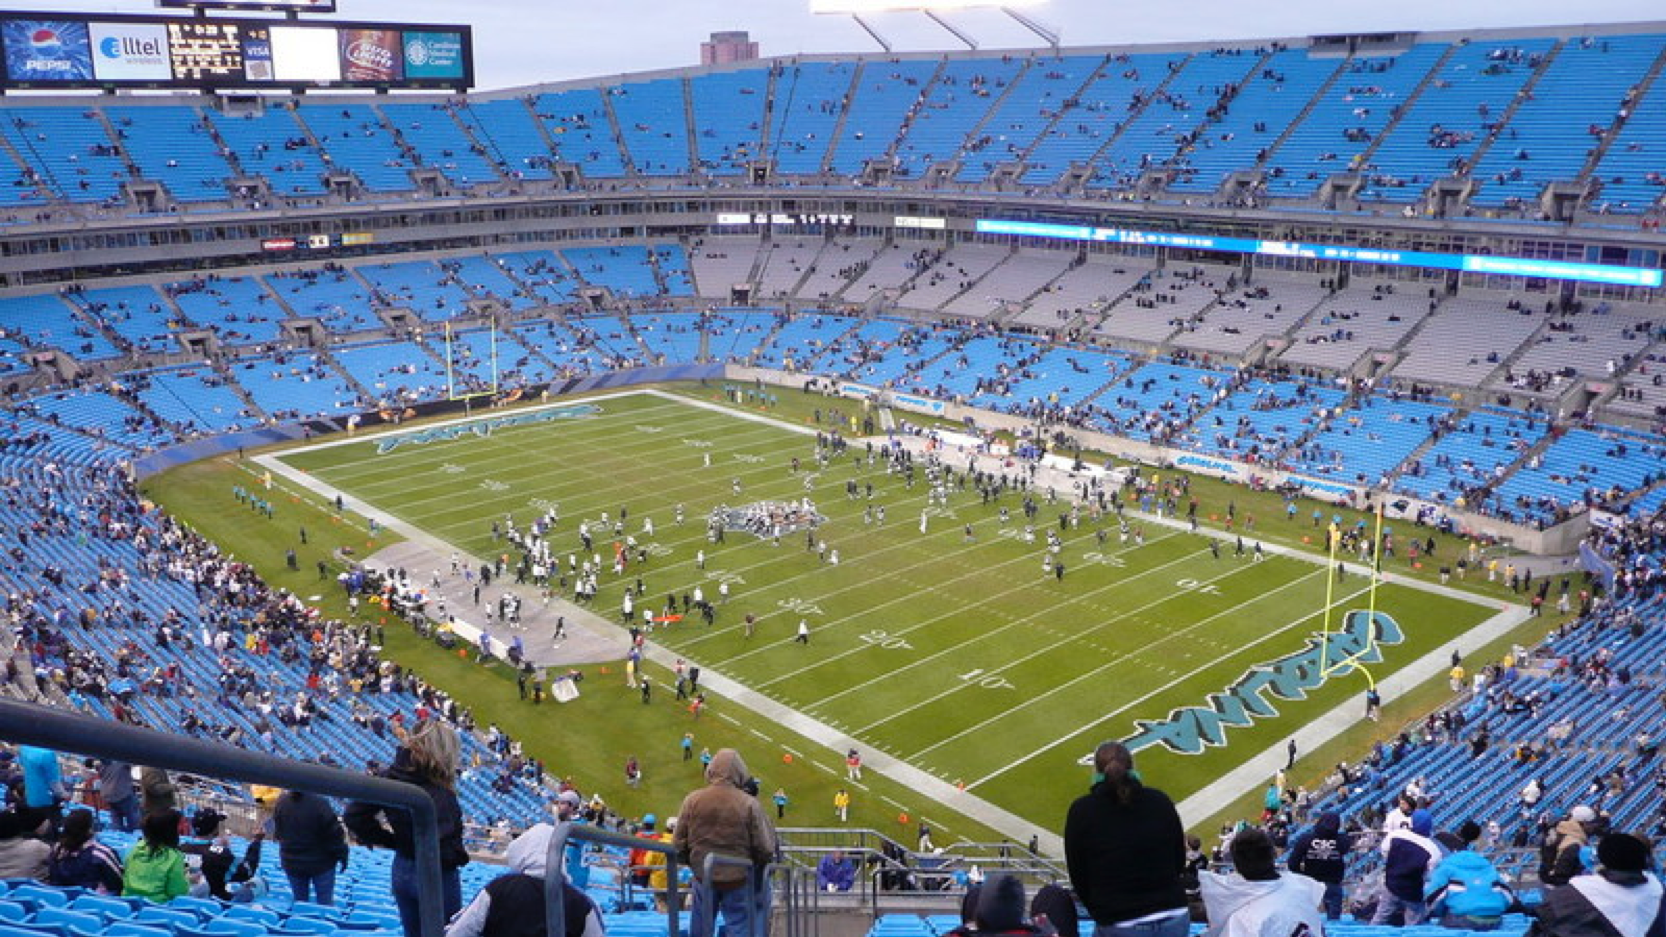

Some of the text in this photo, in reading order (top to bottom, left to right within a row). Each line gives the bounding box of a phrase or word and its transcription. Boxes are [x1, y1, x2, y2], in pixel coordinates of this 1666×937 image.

[245, 45, 270, 57] VISA
[26, 60, 72, 70] PEPSI
[957, 668, 1010, 689] 10
